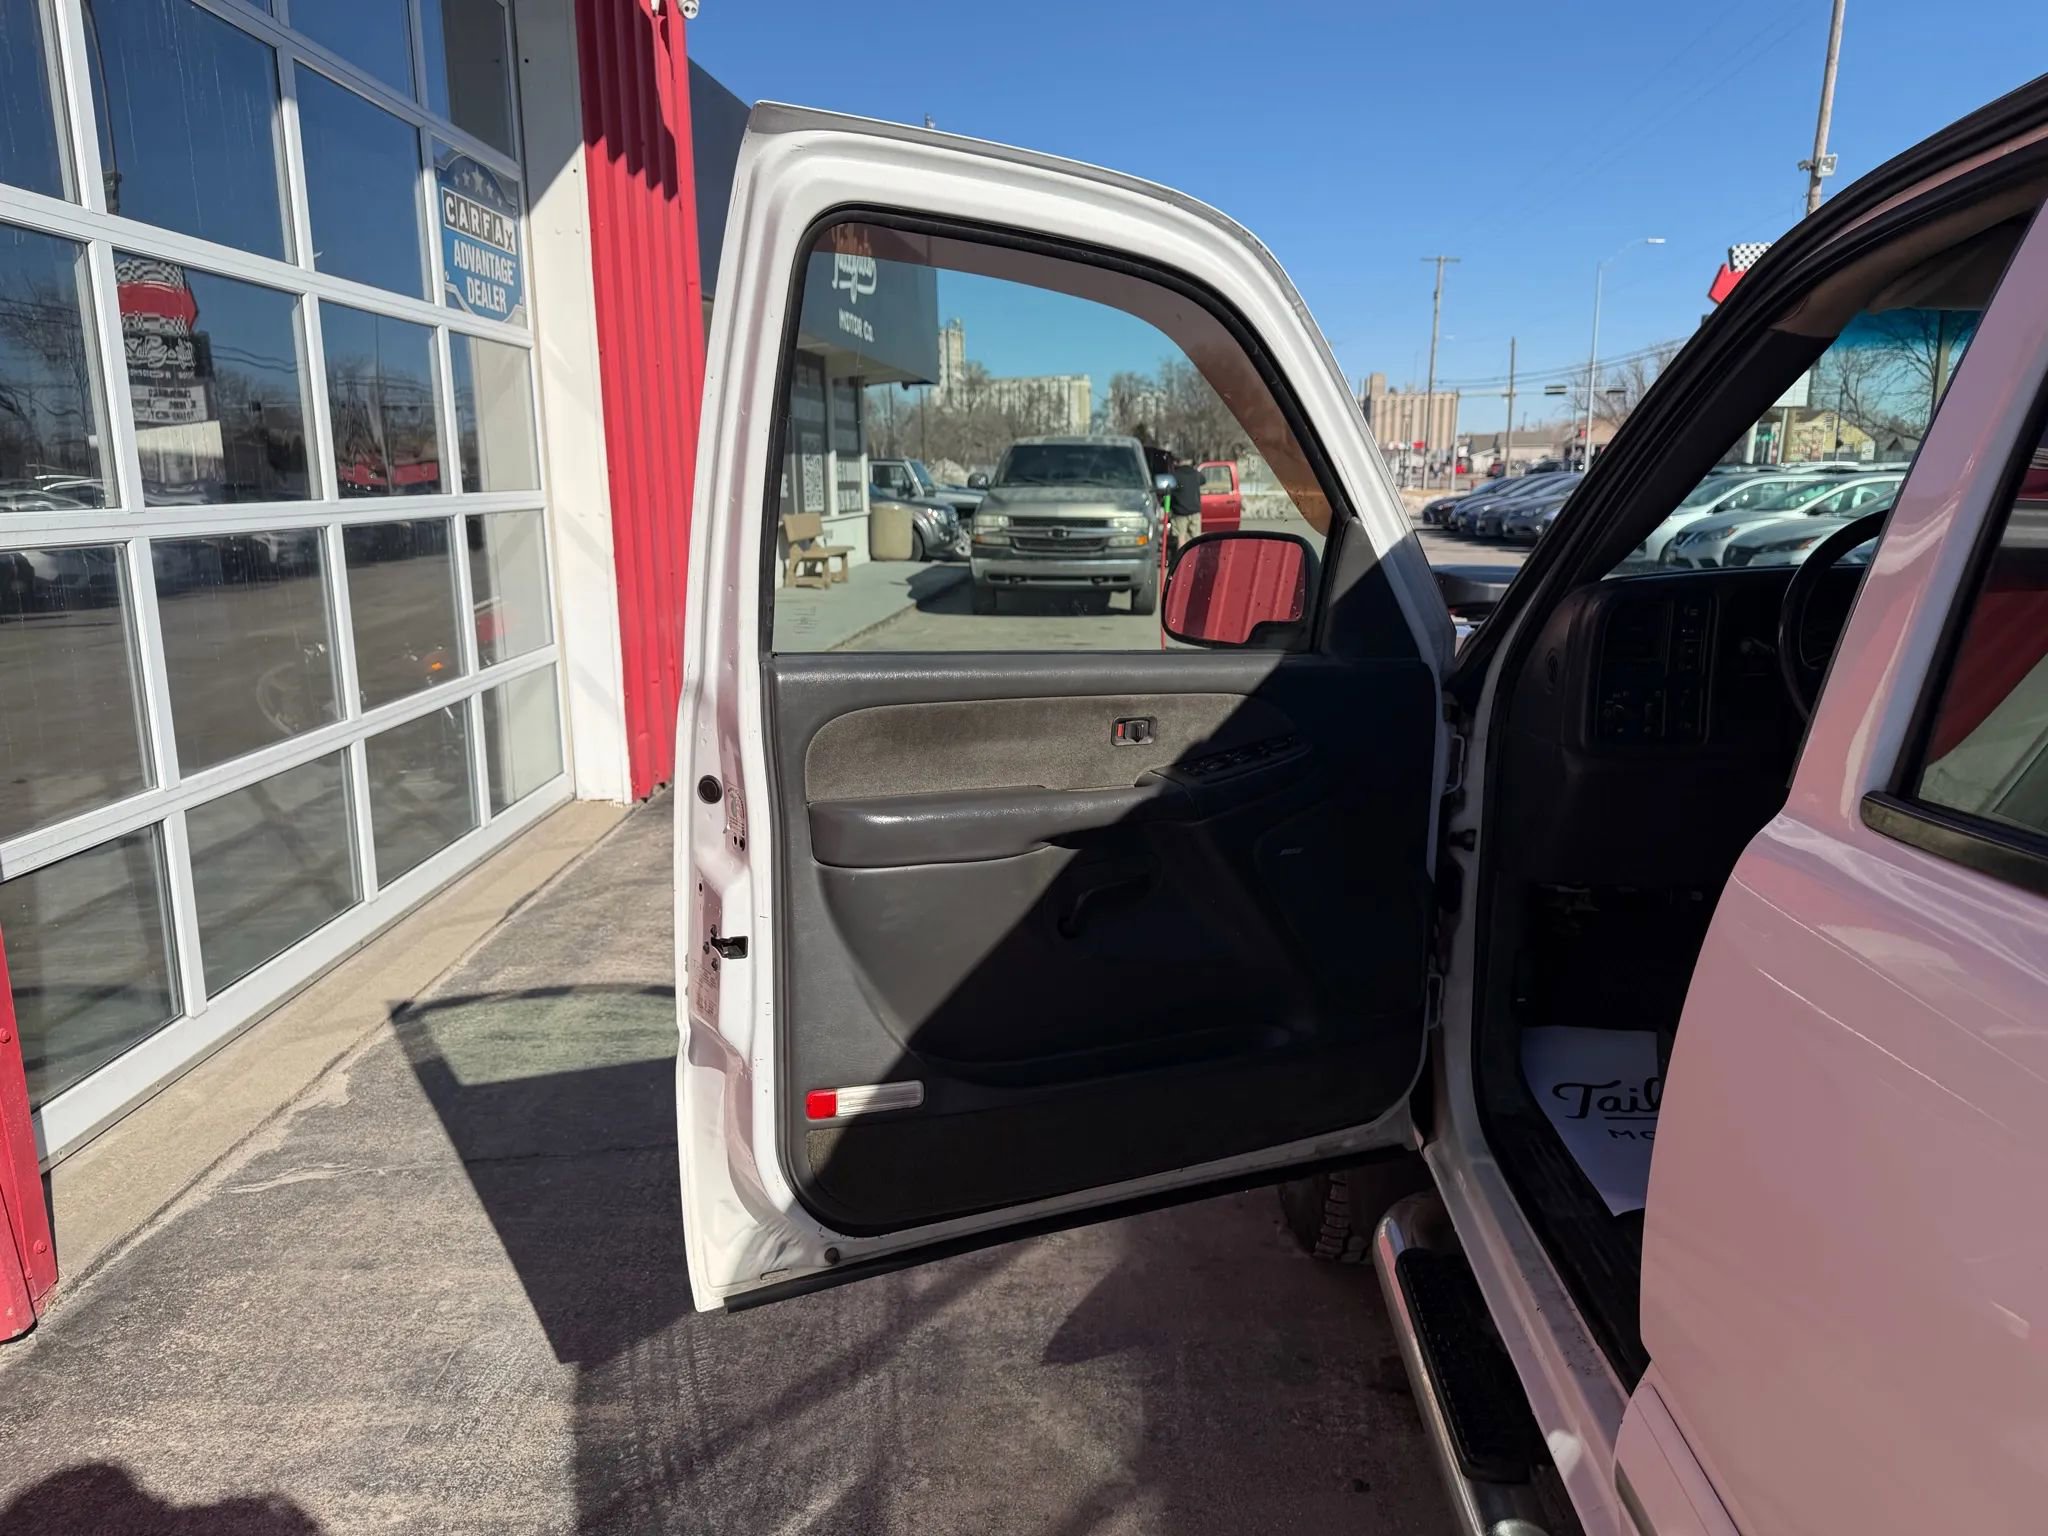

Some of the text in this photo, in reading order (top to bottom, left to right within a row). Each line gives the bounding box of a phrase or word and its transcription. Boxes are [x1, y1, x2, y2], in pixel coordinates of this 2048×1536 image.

[445, 196, 514, 252] CARFAX
[453, 239, 515, 286] ADVANTAGE
[466, 276, 508, 314] DEALER
